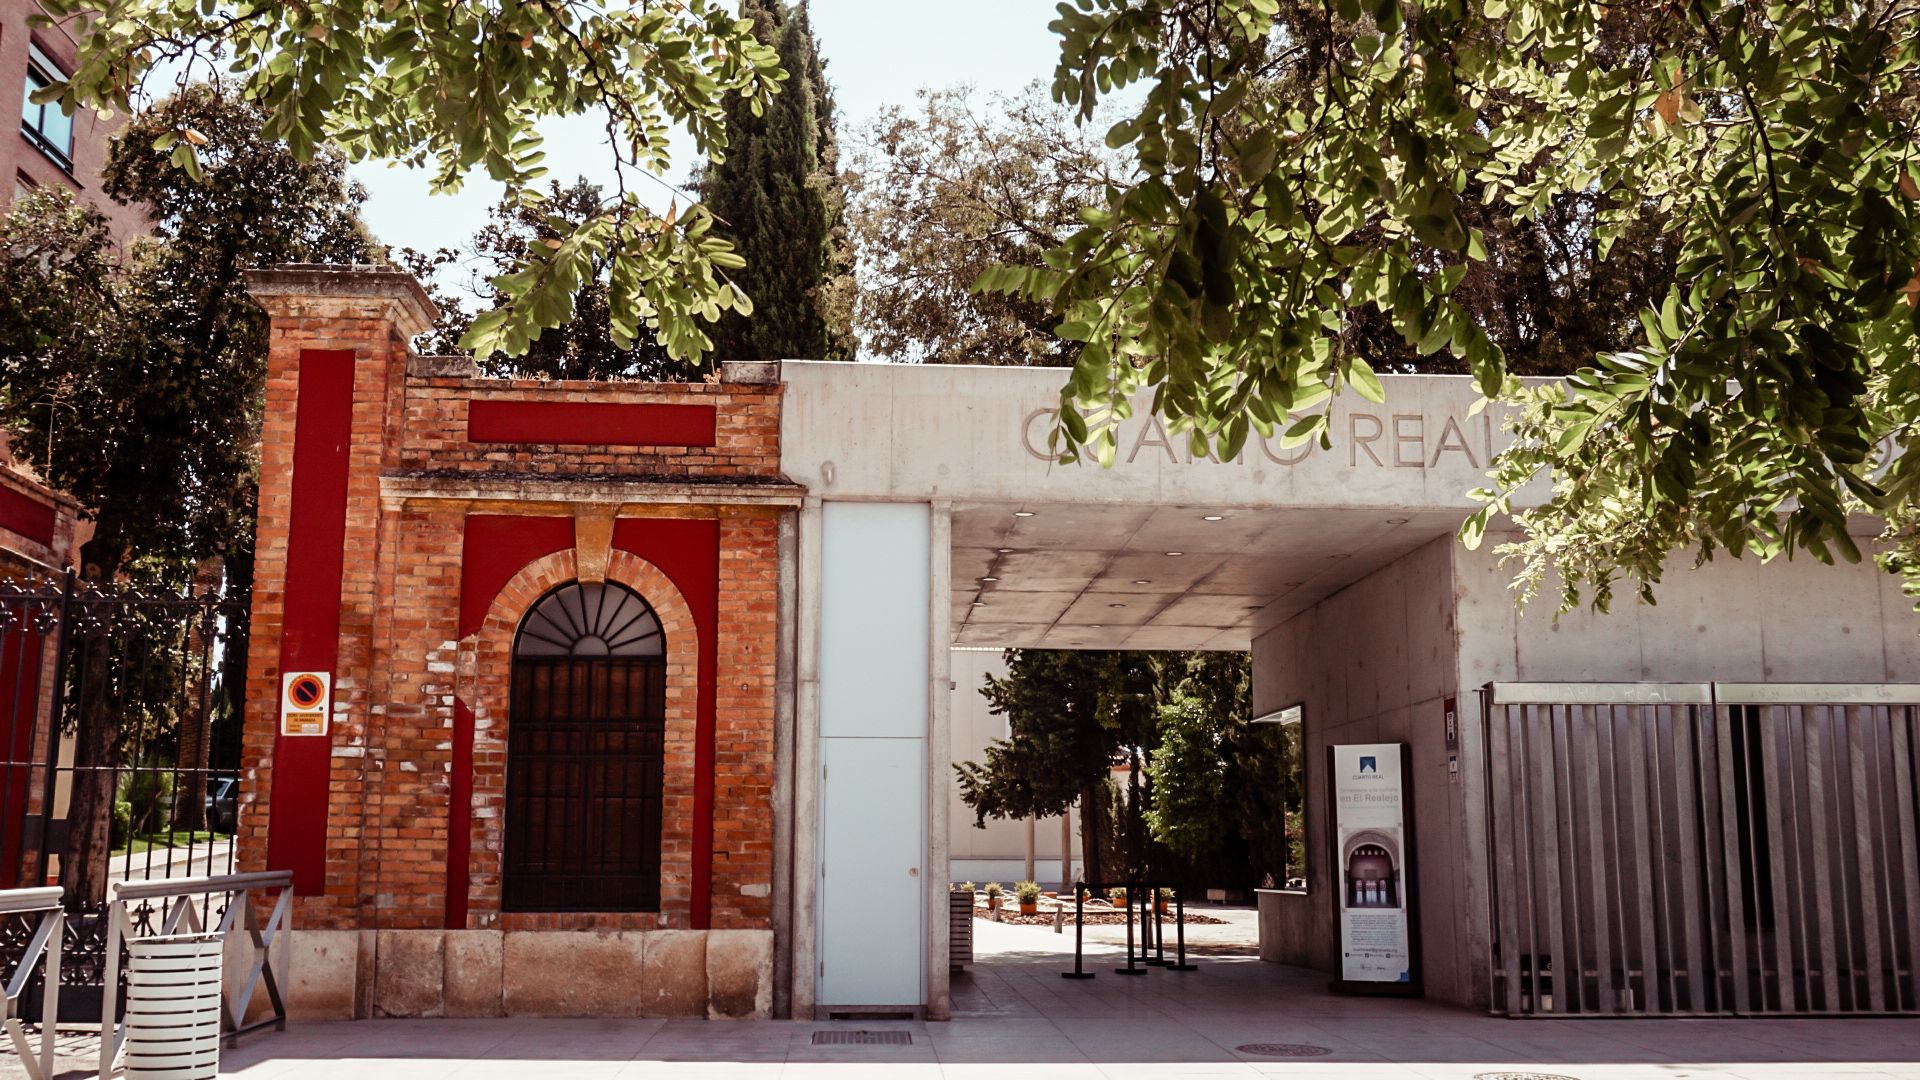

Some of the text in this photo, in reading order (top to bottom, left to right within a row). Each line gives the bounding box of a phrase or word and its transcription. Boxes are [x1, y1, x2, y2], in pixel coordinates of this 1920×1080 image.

[1349, 412, 1503, 469] REAL
[1623, 686, 1673, 701] REAL
[1364, 793, 1399, 804] Realejo
